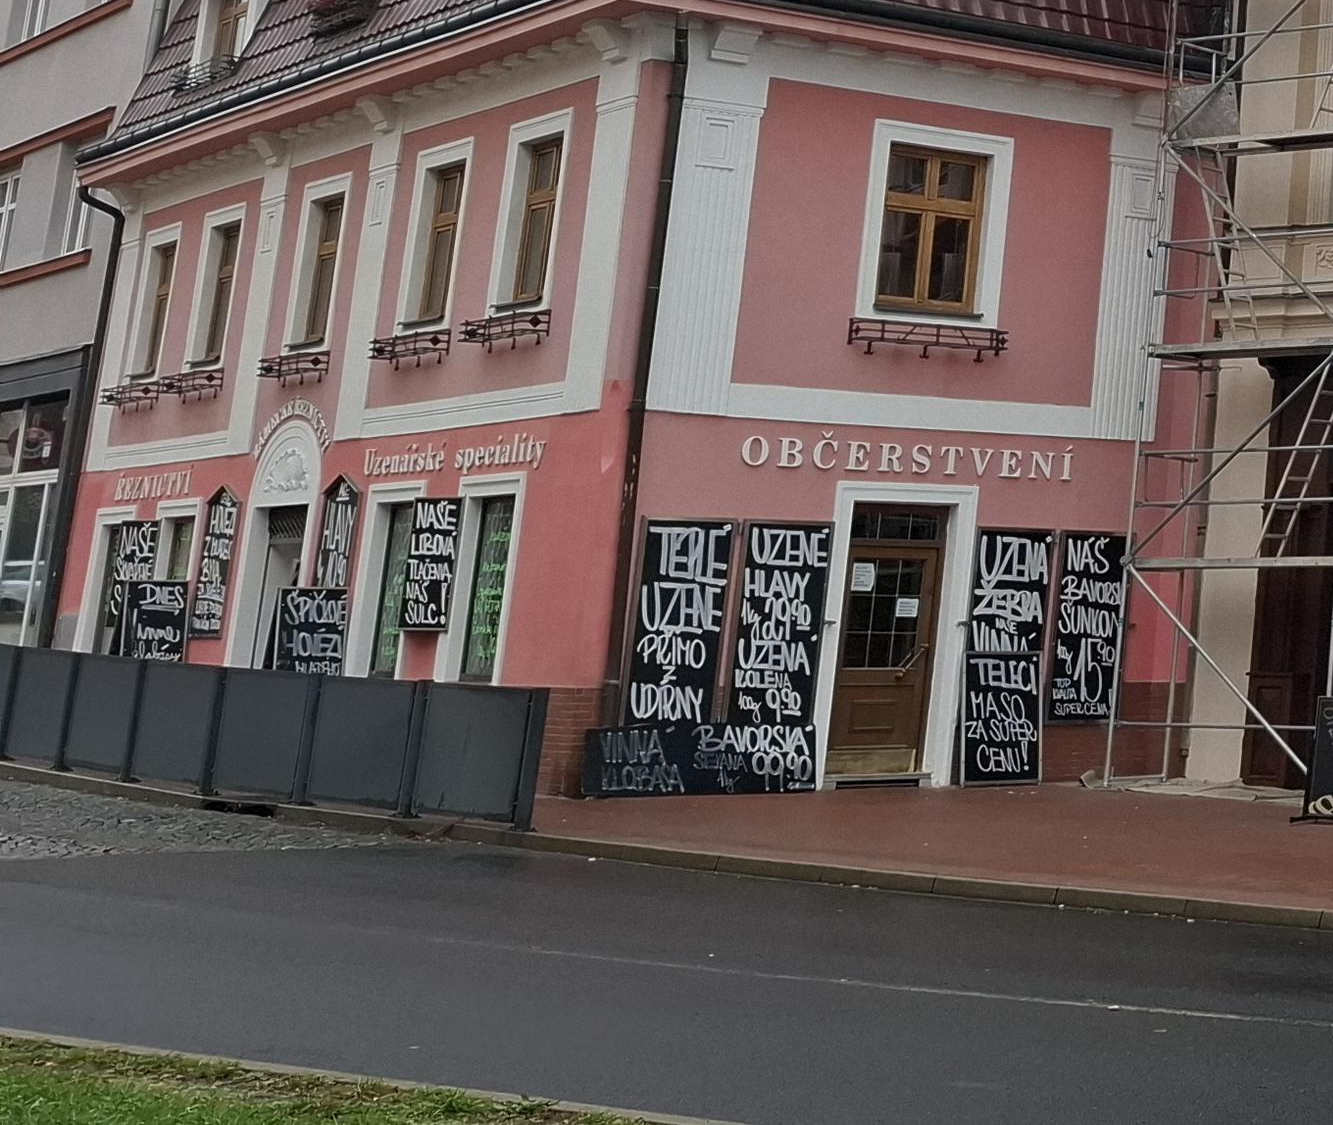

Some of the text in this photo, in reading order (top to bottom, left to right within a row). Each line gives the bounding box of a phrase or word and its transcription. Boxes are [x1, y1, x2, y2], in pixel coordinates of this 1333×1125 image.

[363, 433, 547, 476] Uzenářské speciality
[741, 431, 1075, 481] OBČERSTVENÍ
[115, 464, 194, 501] ŘEZNICTVÍ
[416, 501, 457, 530] NAŠE
[120, 522, 158, 559] NAŠE
[752, 527, 829, 567] UZENÉ
[1068, 537, 1110, 574] NÁŠ
[980, 535, 1052, 584] UZENÁ
[138, 584, 184, 610] DNES
[745, 567, 810, 602] HLAVY
[738, 634, 817, 675] UZENÁ
[735, 668, 793, 690] KOLENA
[969, 656, 1038, 695] TELECÍ
[970, 691, 1026, 722] MASO
[691, 724, 813, 755] BAVORSKÁ
[965, 719, 1037, 742] ZA SUPER
[976, 741, 1029, 773] CENU!
